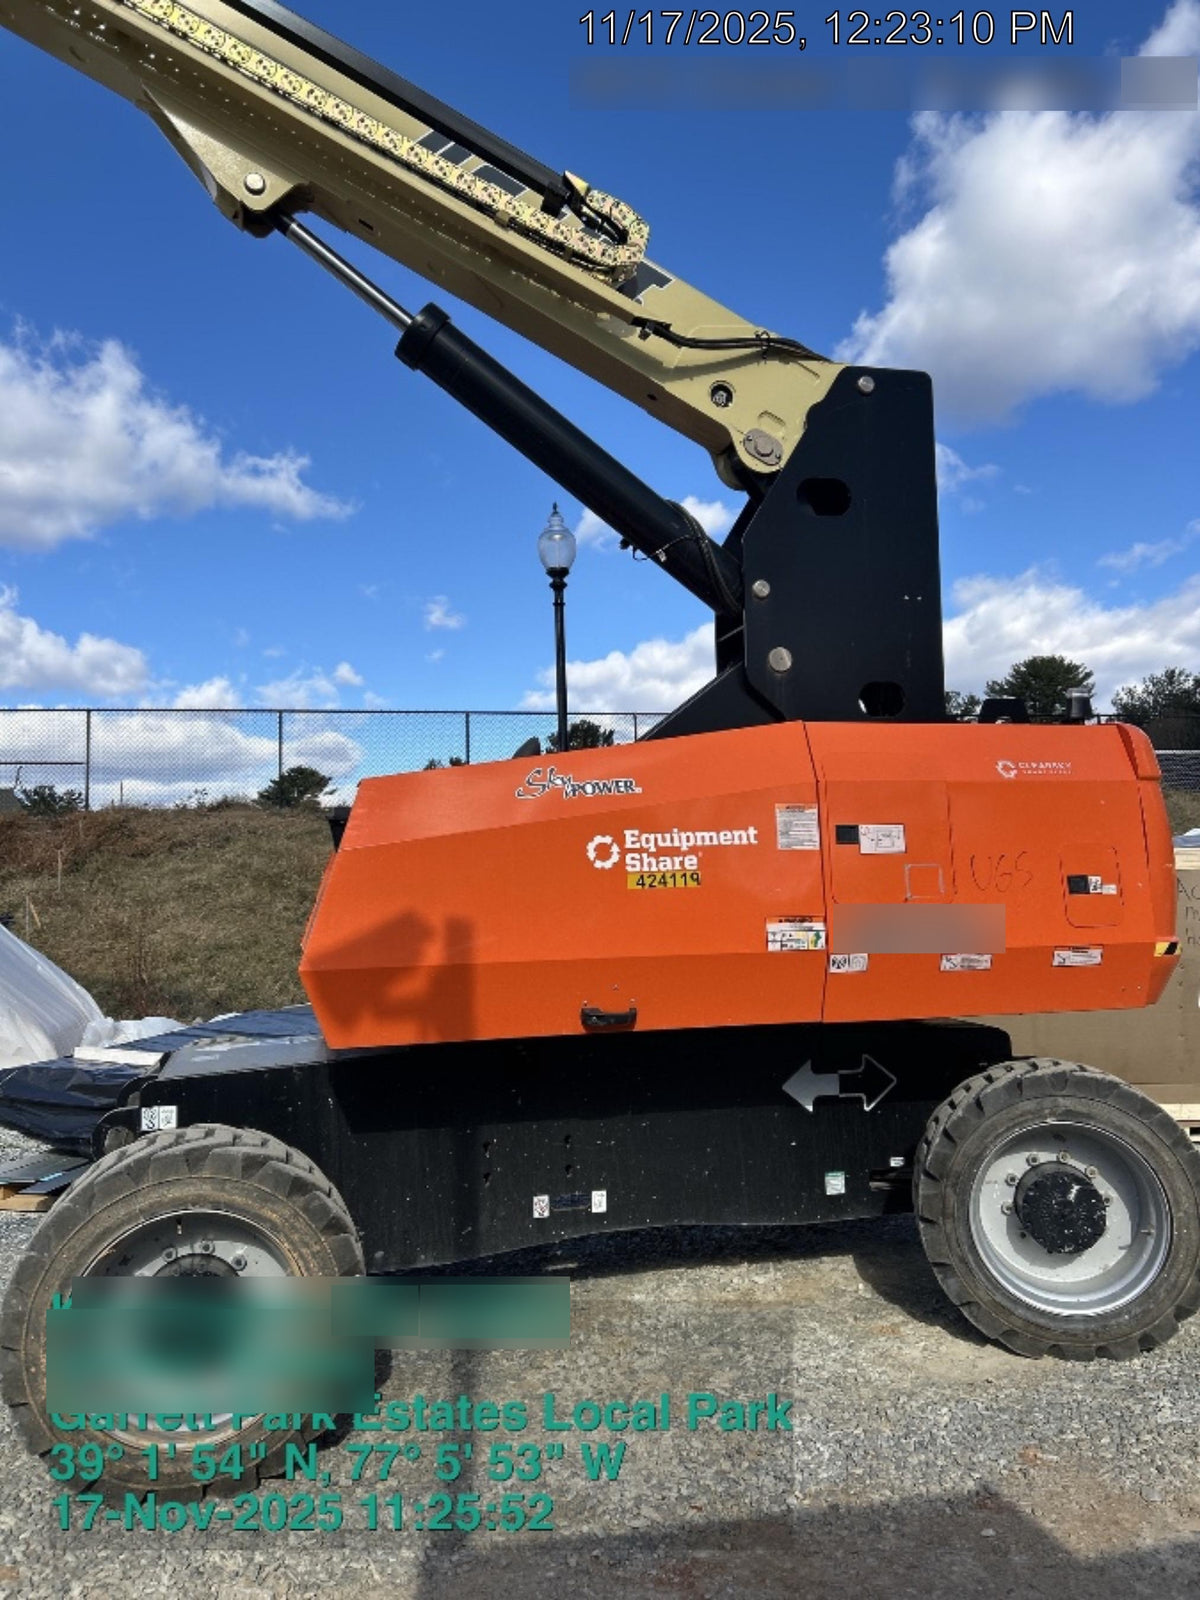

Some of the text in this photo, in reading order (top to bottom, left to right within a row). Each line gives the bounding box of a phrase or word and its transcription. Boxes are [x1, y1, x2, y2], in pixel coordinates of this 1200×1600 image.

[624, 827, 758, 851] Equipment
[625, 852, 698, 872] Share
[636, 872, 701, 888] 424119
